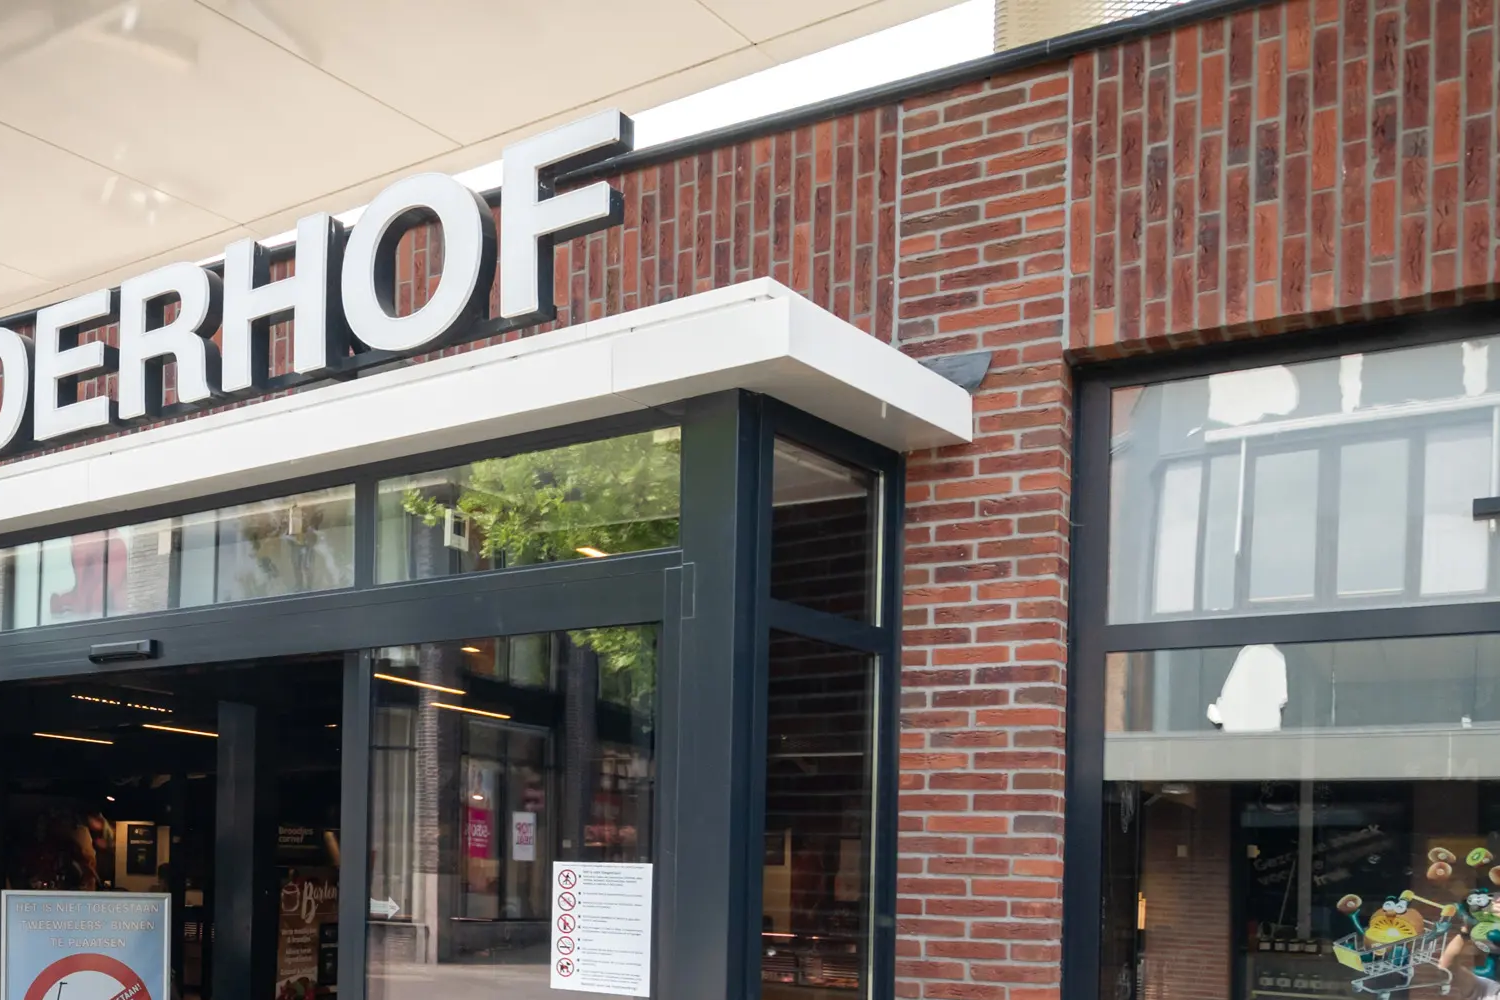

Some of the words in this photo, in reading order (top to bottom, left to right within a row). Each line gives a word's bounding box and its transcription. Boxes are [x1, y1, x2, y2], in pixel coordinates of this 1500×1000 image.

[16, 903, 36, 912] HET
[42, 903, 51, 912] IS
[56, 903, 81, 912] NIET
[87, 903, 159, 913] TOEGESTAAN
[111, 921, 155, 930] BINNEN
[50, 937, 64, 947] TE
[69, 938, 125, 947] PLAATSEN
